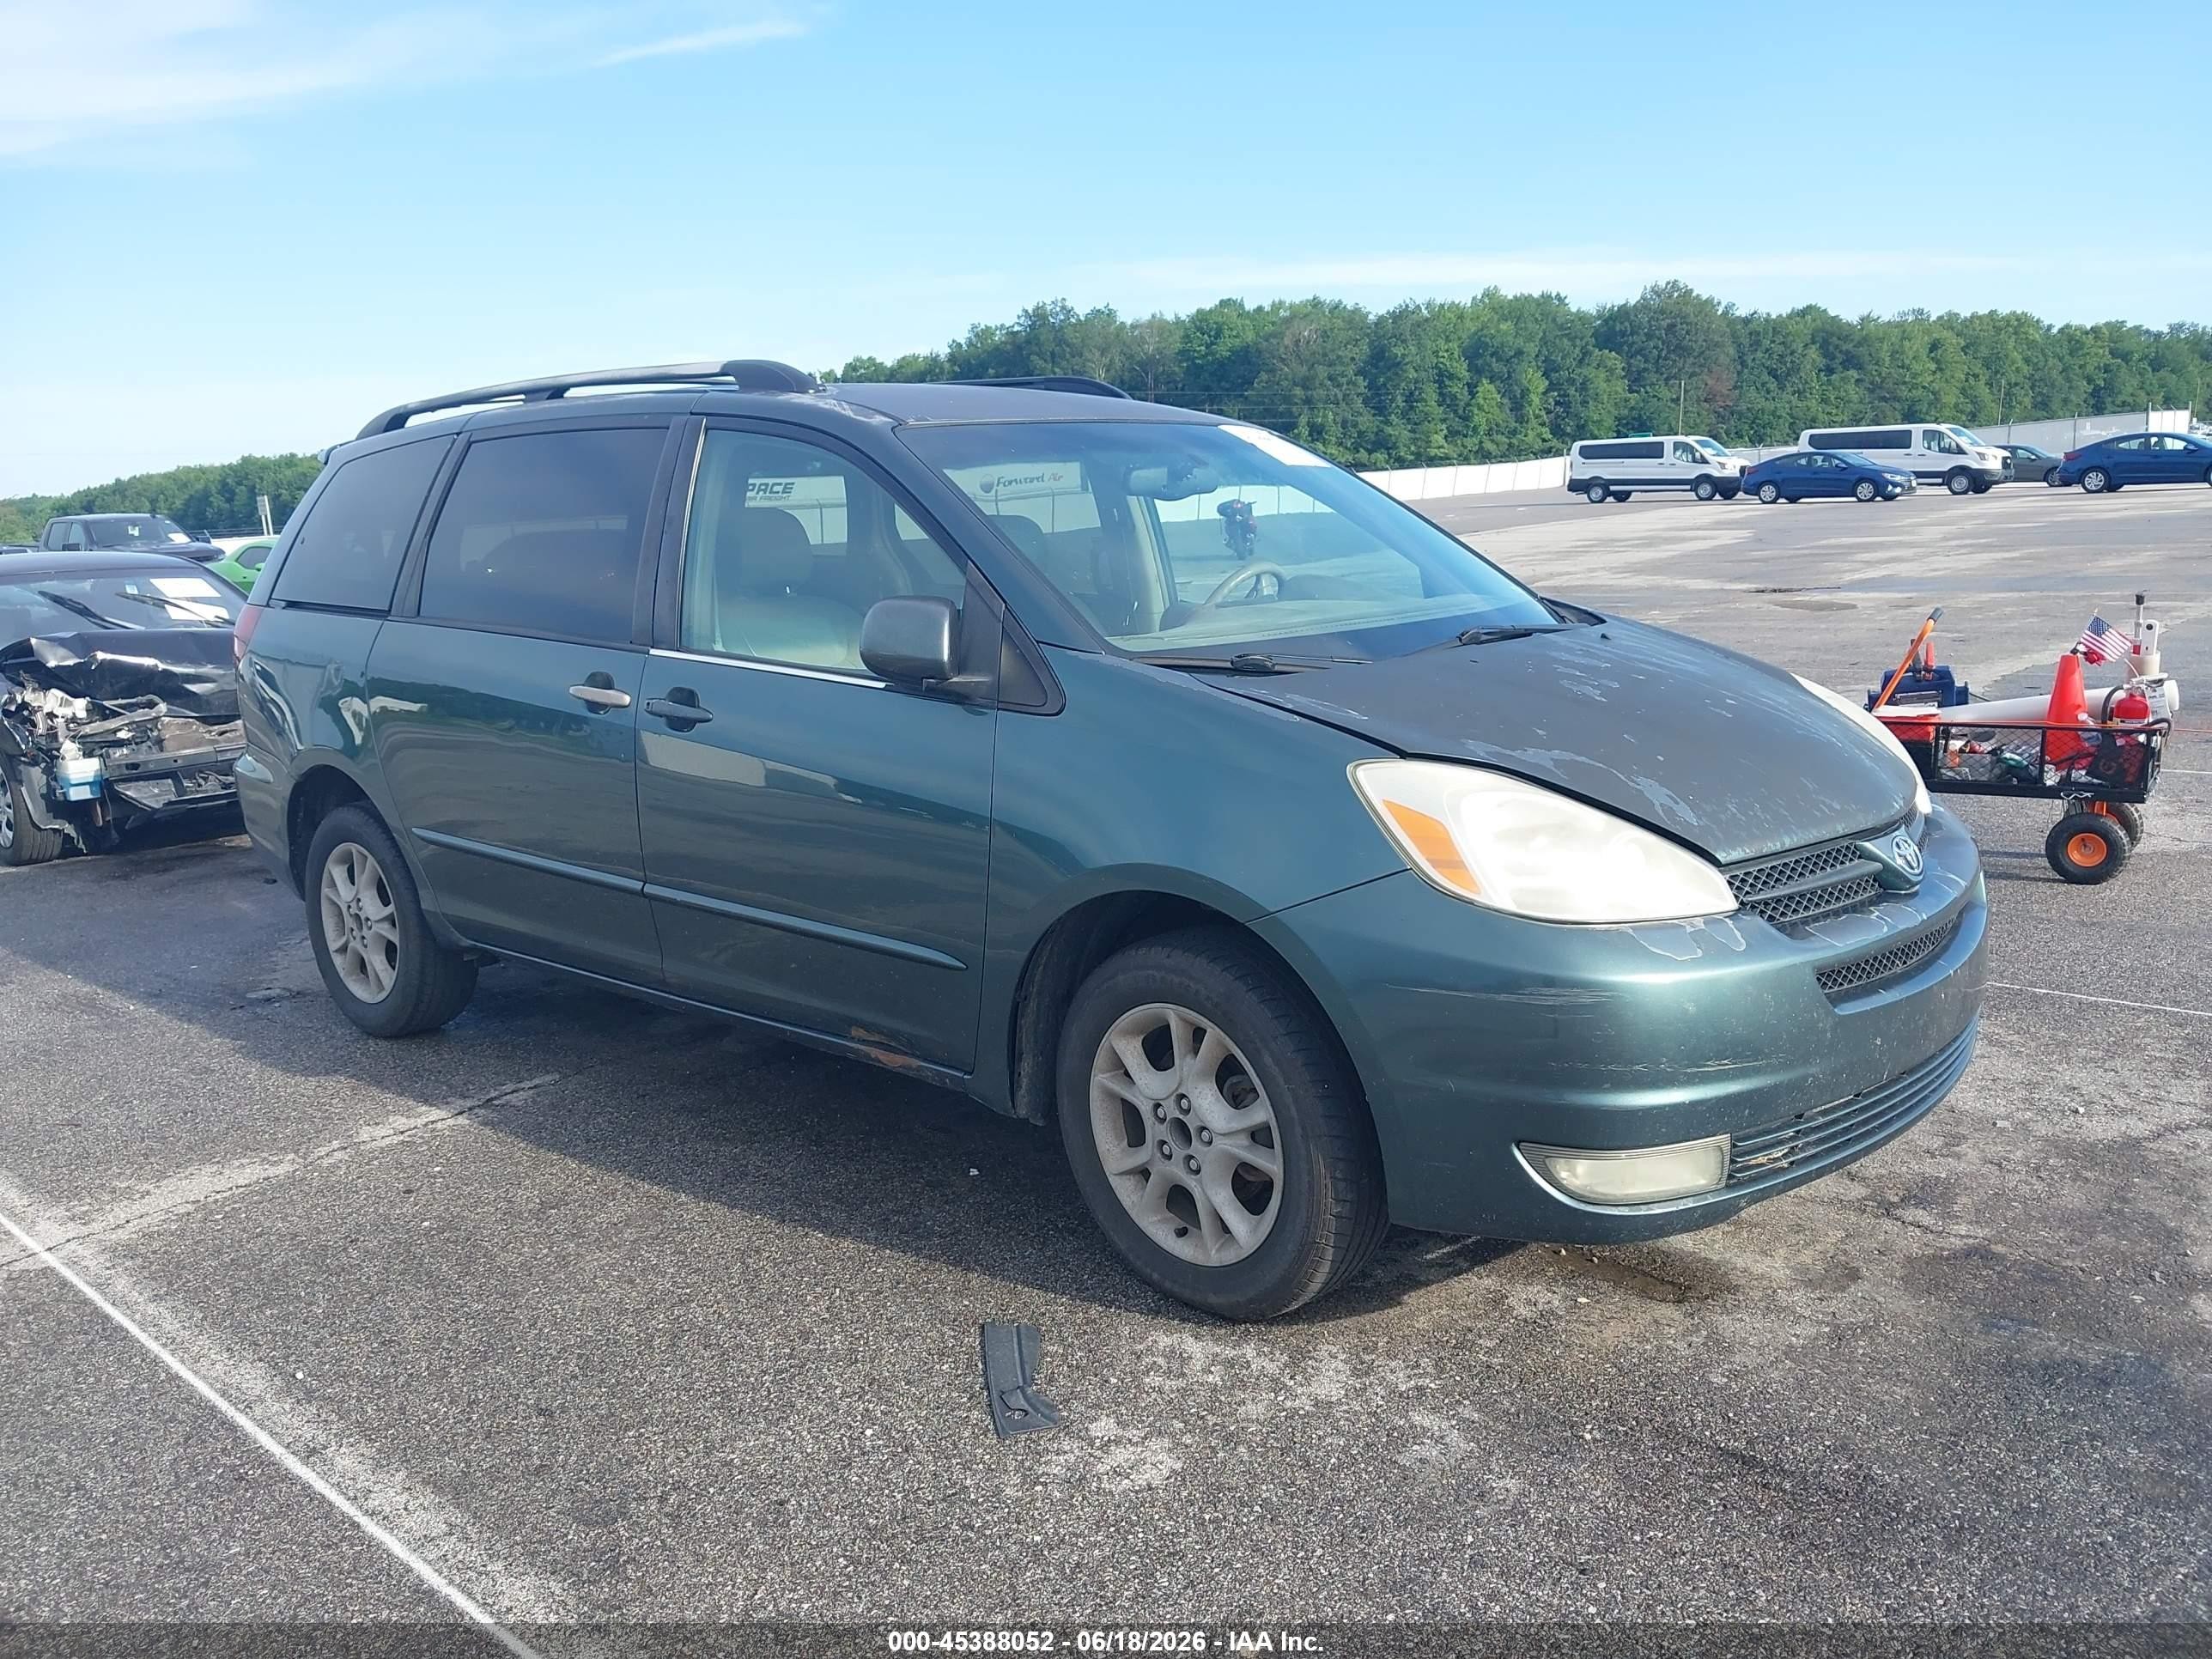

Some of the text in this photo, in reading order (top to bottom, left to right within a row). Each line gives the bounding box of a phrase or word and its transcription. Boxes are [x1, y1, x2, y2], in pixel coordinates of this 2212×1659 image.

[996, 471, 1065, 488] Forward Air
[748, 482, 795, 495] PACE
